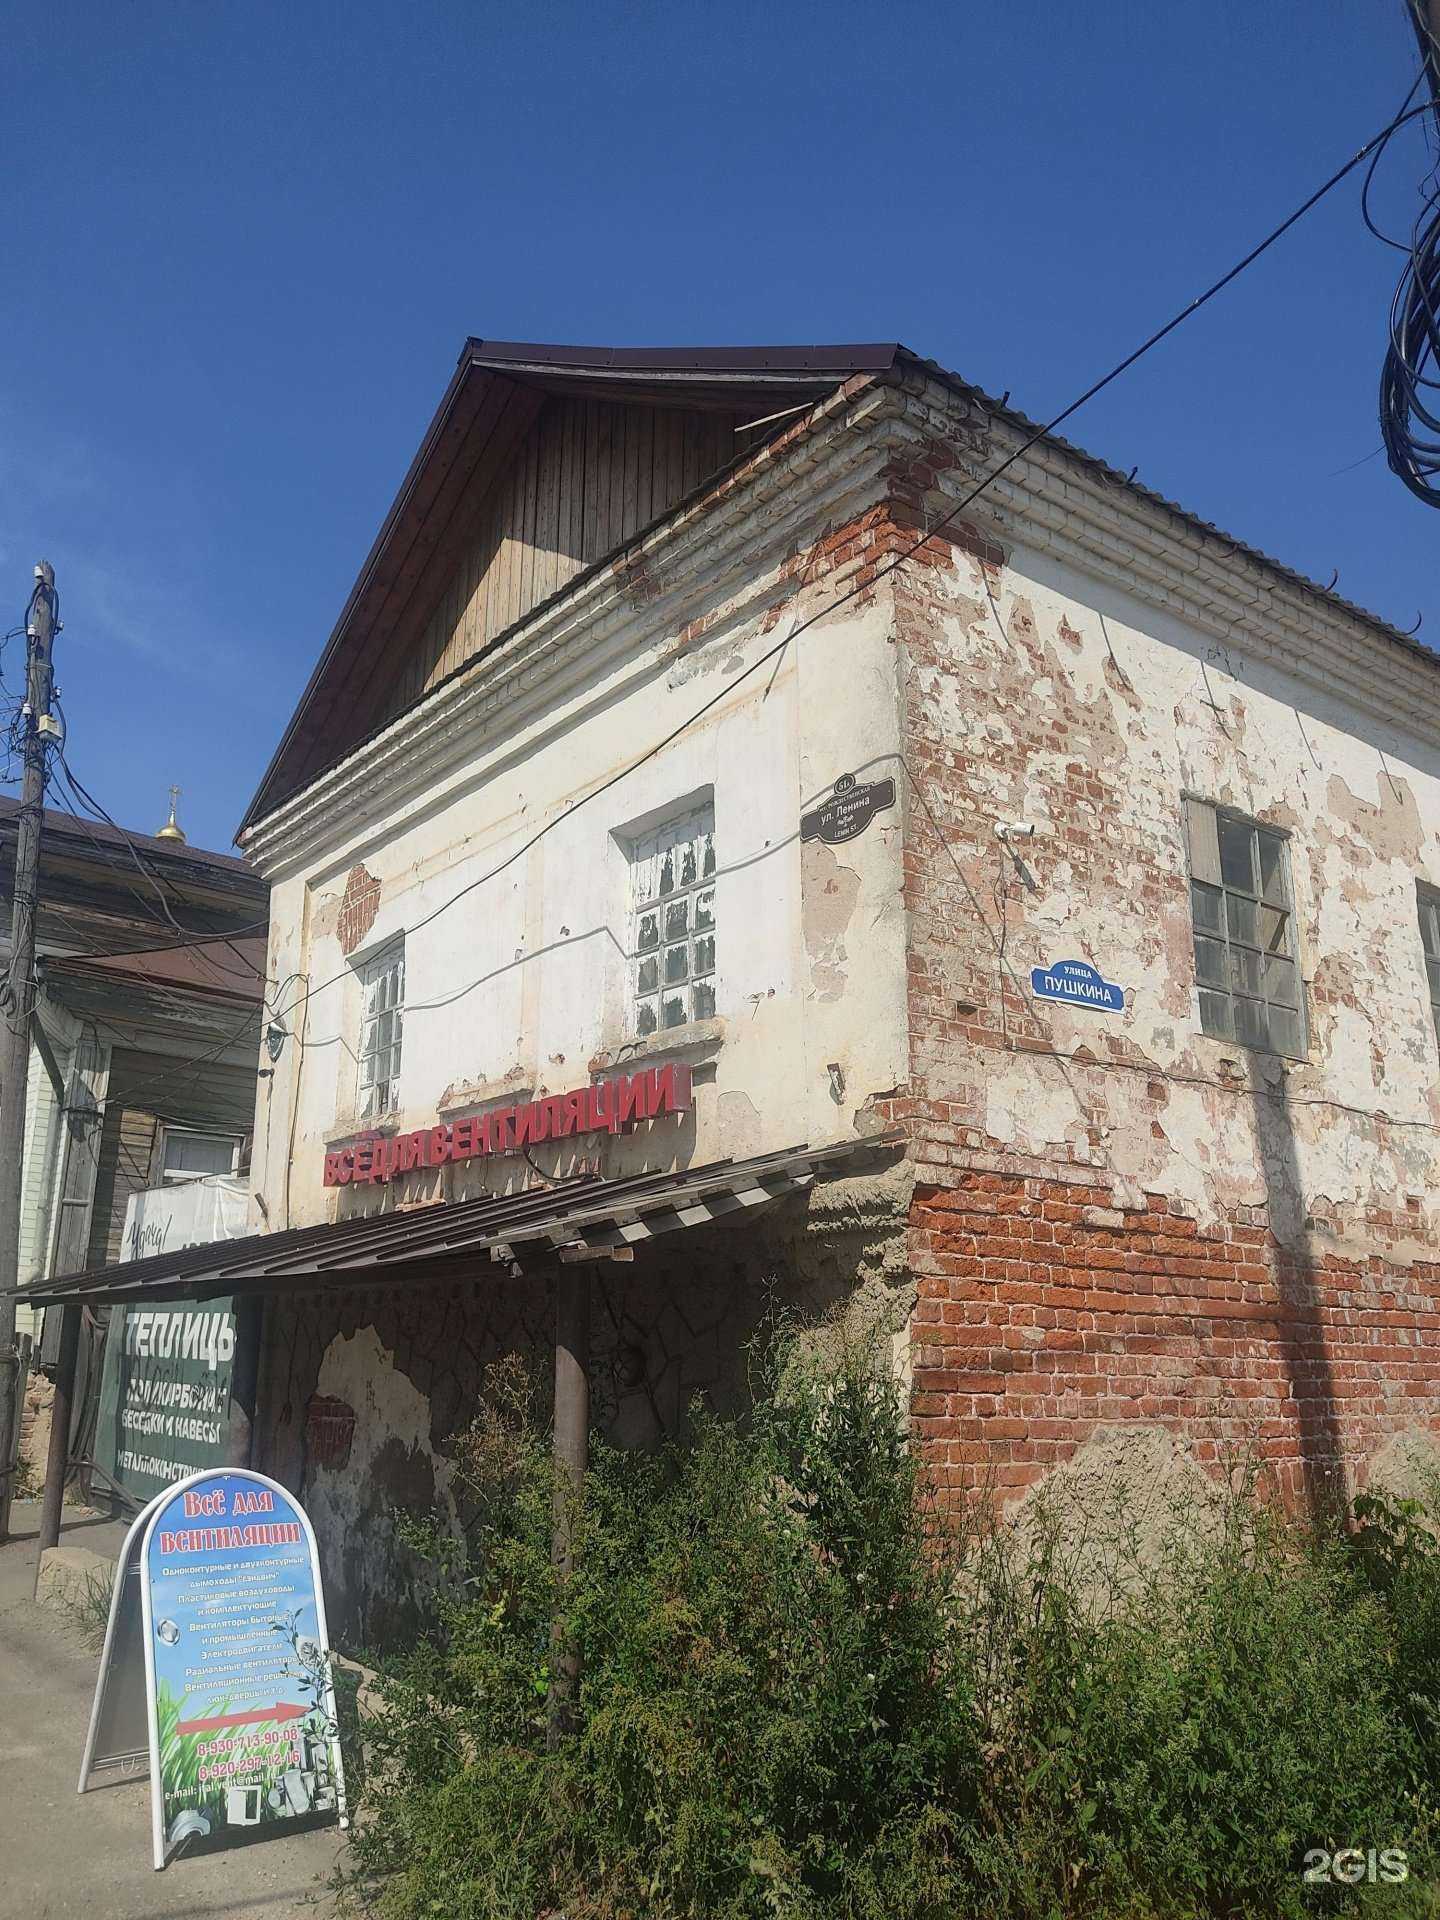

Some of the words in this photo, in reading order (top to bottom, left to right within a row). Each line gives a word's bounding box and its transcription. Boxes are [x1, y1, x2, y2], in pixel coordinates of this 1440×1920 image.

[821, 812, 834, 826] ул.
[836, 796, 870, 818] Ленина
[834, 828, 850, 838] LENIN
[1064, 966, 1092, 979] УЛИЦА
[1044, 976, 1112, 1003] ПУШКИНА
[369, 1129, 431, 1184] ДЛЯ
[431, 1063, 690, 1167] ВЕНТИЛЯЦИИ
[122, 1408, 165, 1436] БЕСЕДКИ
[166, 1415, 174, 1437] И
[175, 1415, 222, 1444] НАВЕСЫ
[183, 1489, 227, 1518] Всё
[162, 1562, 232, 1577] Одноконтурные
[240, 1557, 305, 1570] двухконтурные
[190, 1576, 237, 1588] дымоходы
[178, 1591, 238, 1604] Пластиковые
[238, 1586, 295, 1598] воздуховоды
[205, 1600, 277, 1615] комплектующие
[190, 1618, 250, 1632] Вентиляторы
[250, 1613, 290, 1624] бытовые
[209, 1630, 279, 1645] промышленные
[201, 1642, 284, 1660] Электродвигатели
[185, 1663, 242, 1677] Радиальные
[184, 1676, 264, 1692] Вентиляционные
[197, 1728, 298, 1757] 8-930-713-90-08
[199, 1750, 301, 1781] 8-920-297-12-16
[164, 1786, 197, 1800] e-mail:
